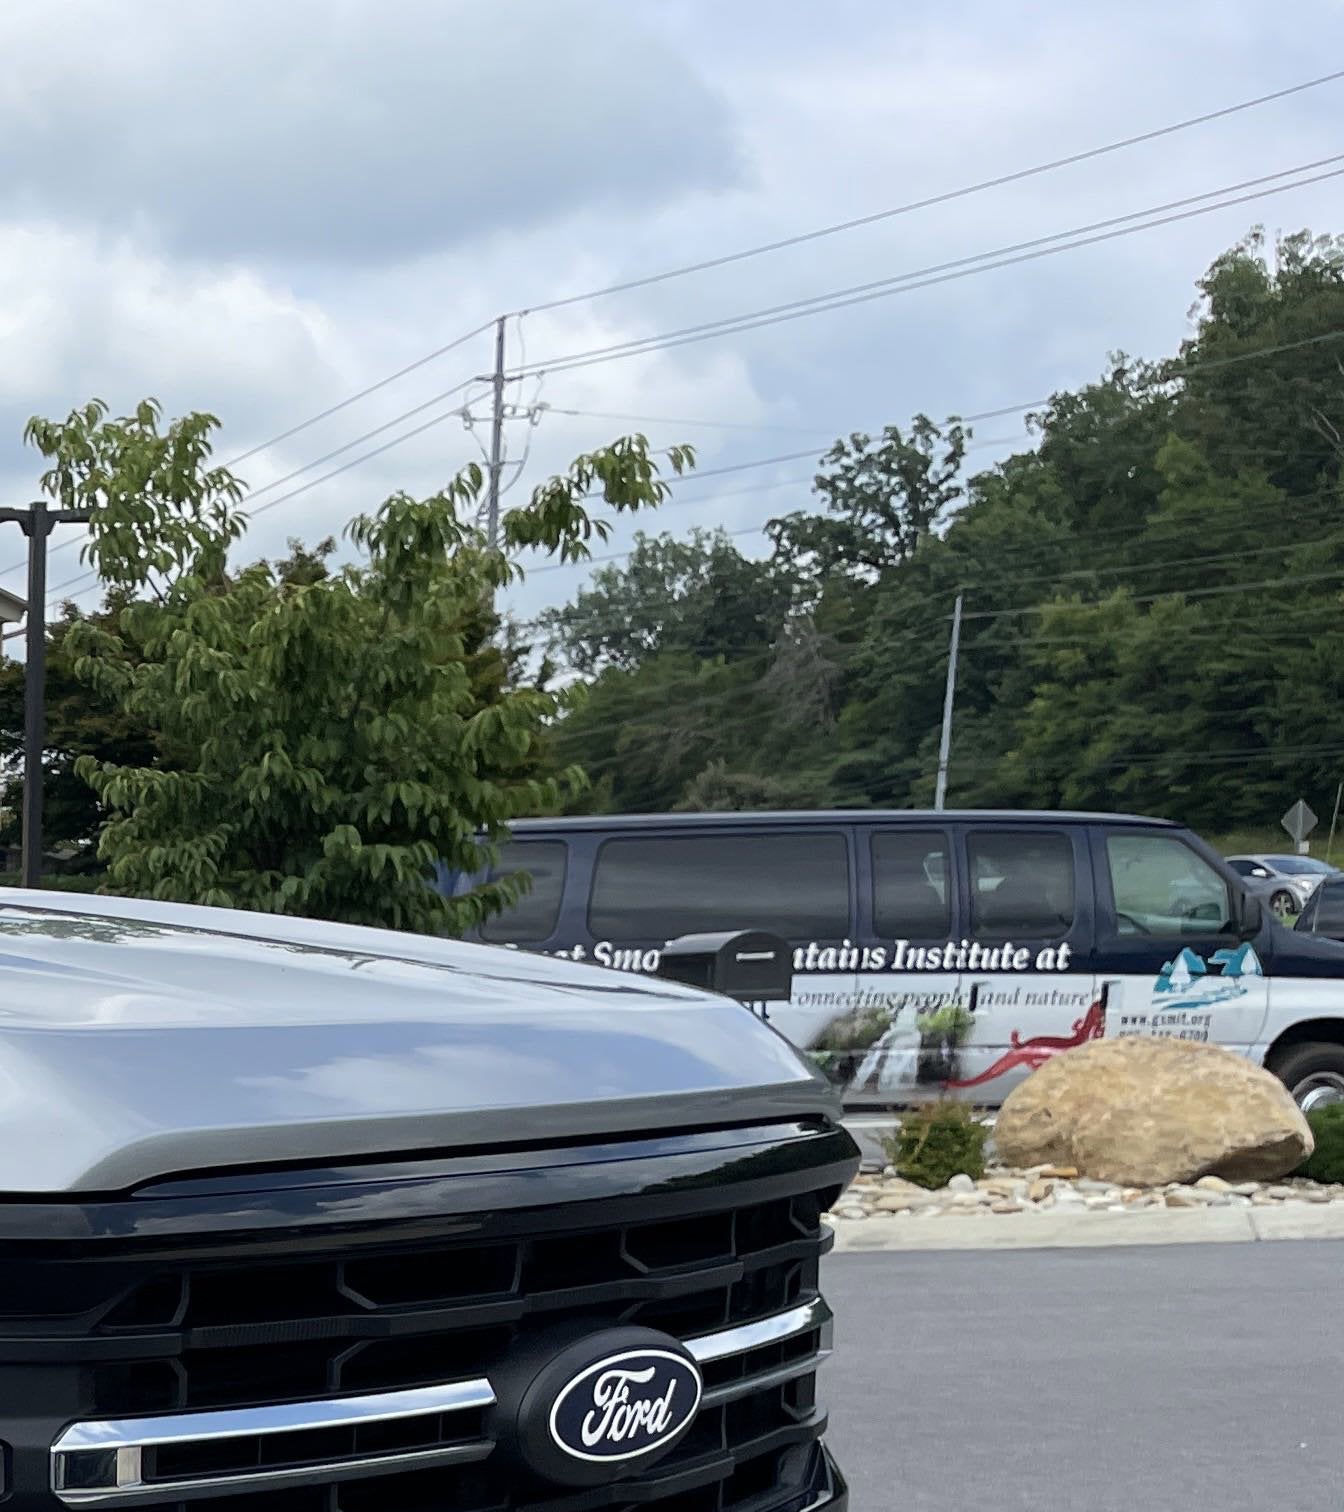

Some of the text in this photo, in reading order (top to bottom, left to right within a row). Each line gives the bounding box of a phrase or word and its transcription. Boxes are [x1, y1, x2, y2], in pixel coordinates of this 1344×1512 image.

[593, 940, 673, 972] Smo
[891, 939, 1030, 971] Institute
[1036, 941, 1072, 971] at
[581, 1366, 678, 1447] Ford
